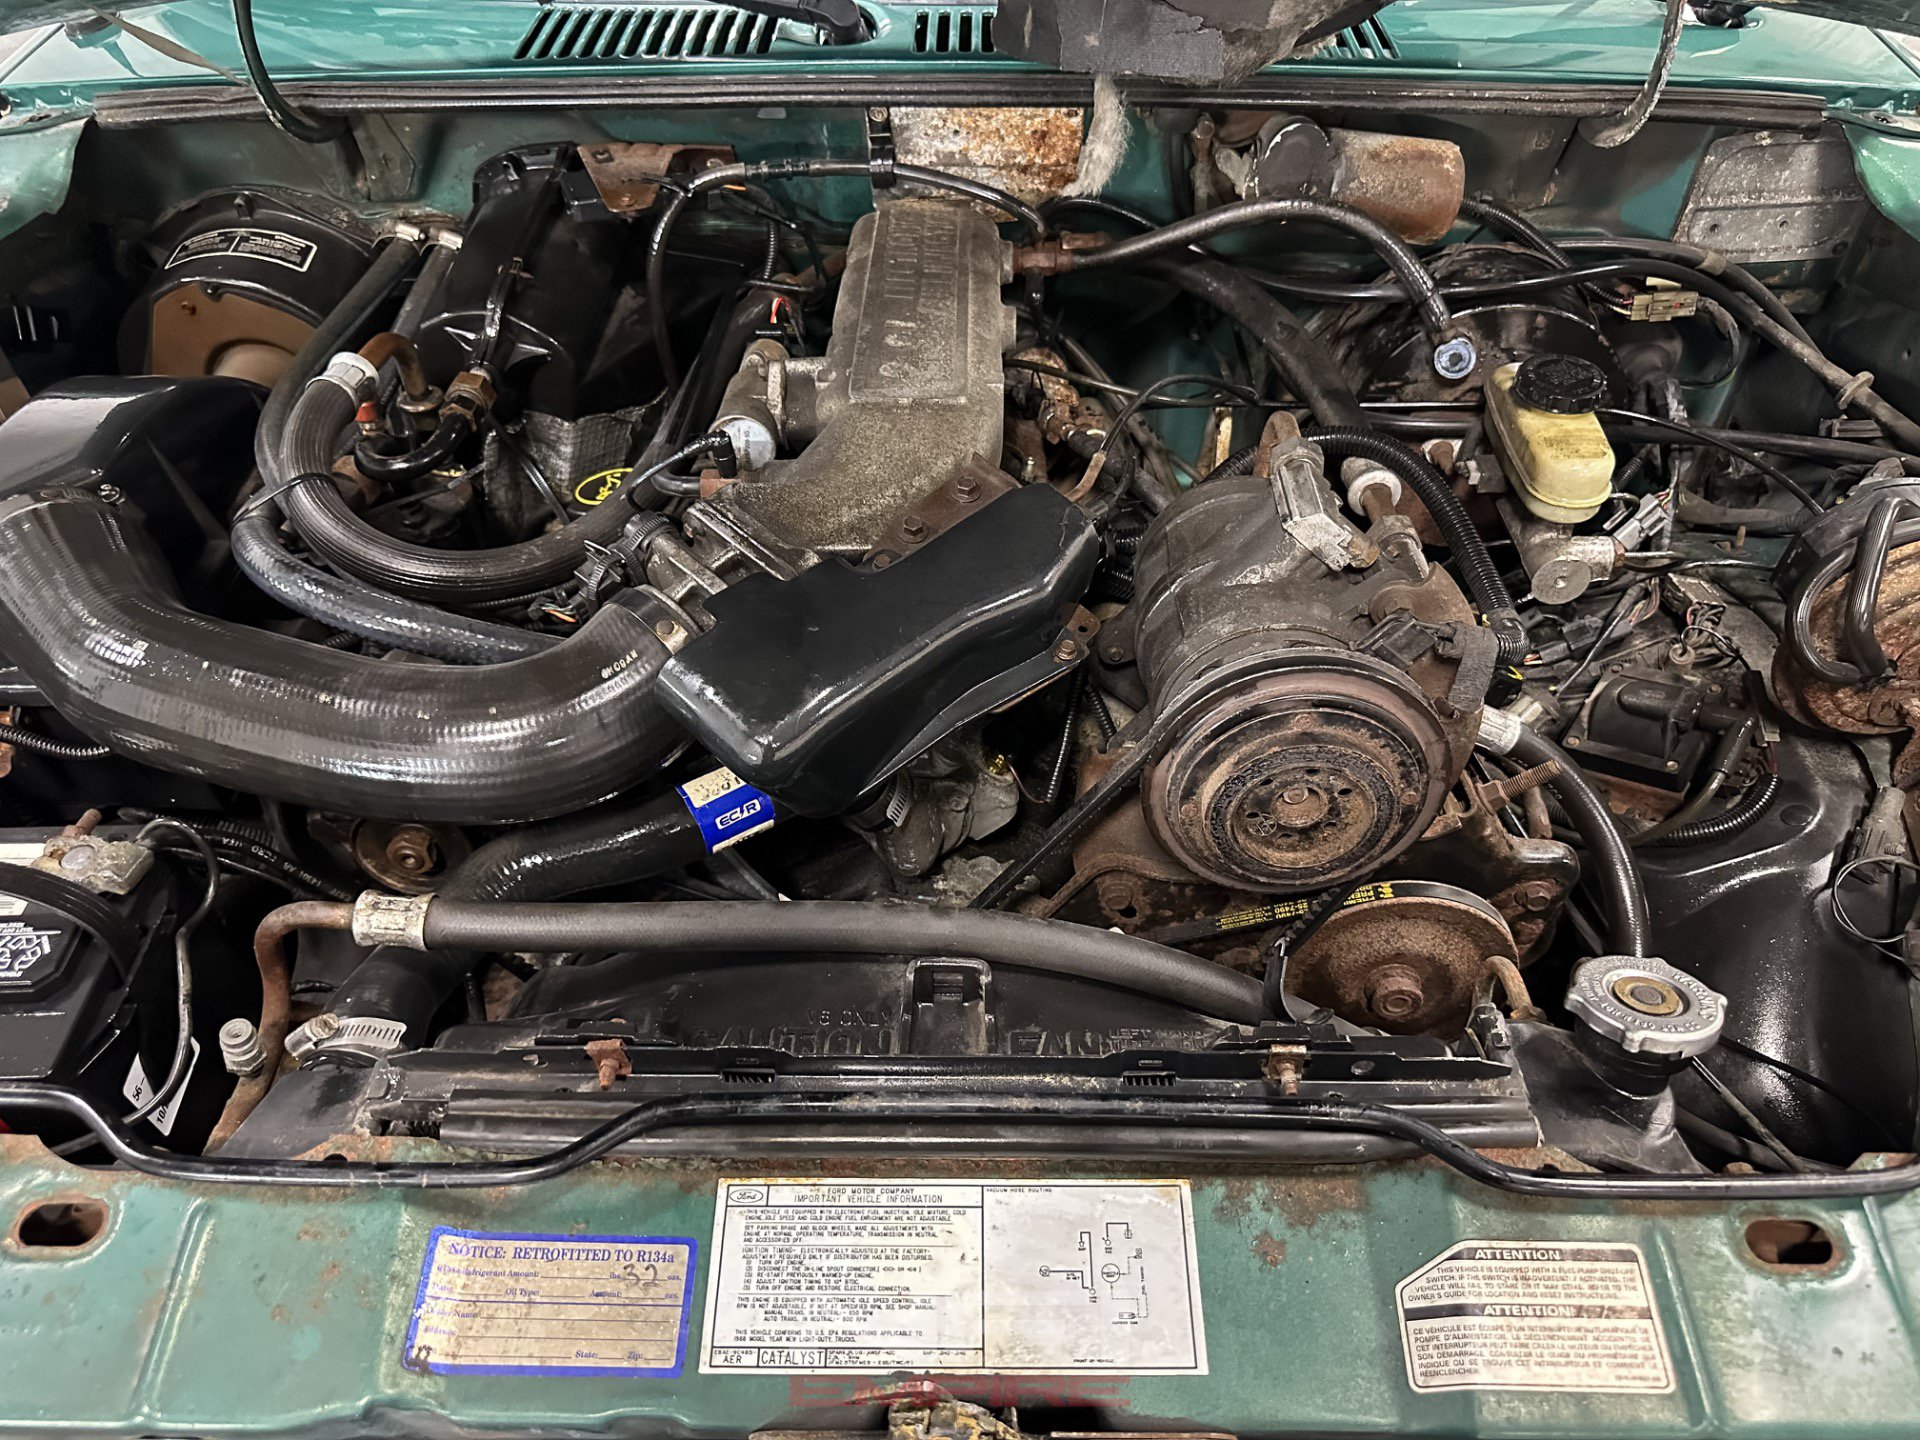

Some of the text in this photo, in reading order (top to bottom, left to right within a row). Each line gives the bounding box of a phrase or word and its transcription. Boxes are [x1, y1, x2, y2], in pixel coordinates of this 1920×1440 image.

[132, 1085, 143, 1102] 56
[736, 1191, 757, 1200] Ford
[794, 1194, 943, 1204] IMPORTANT VEHICLE INFORMATION
[449, 1243, 674, 1263] NOTICE: RETROFITTED TO R134a
[1474, 1249, 1561, 1261] ATTENTION
[519, 1288, 540, 1297] Type:
[1483, 1305, 1571, 1317] ATTENTION
[1413, 1328, 1424, 1336] CE
[1416, 1344, 1430, 1352] CET
[575, 1350, 643, 1361] State: Zip:
[723, 1355, 742, 1364] AER
[761, 1350, 825, 1365] CATALYST
